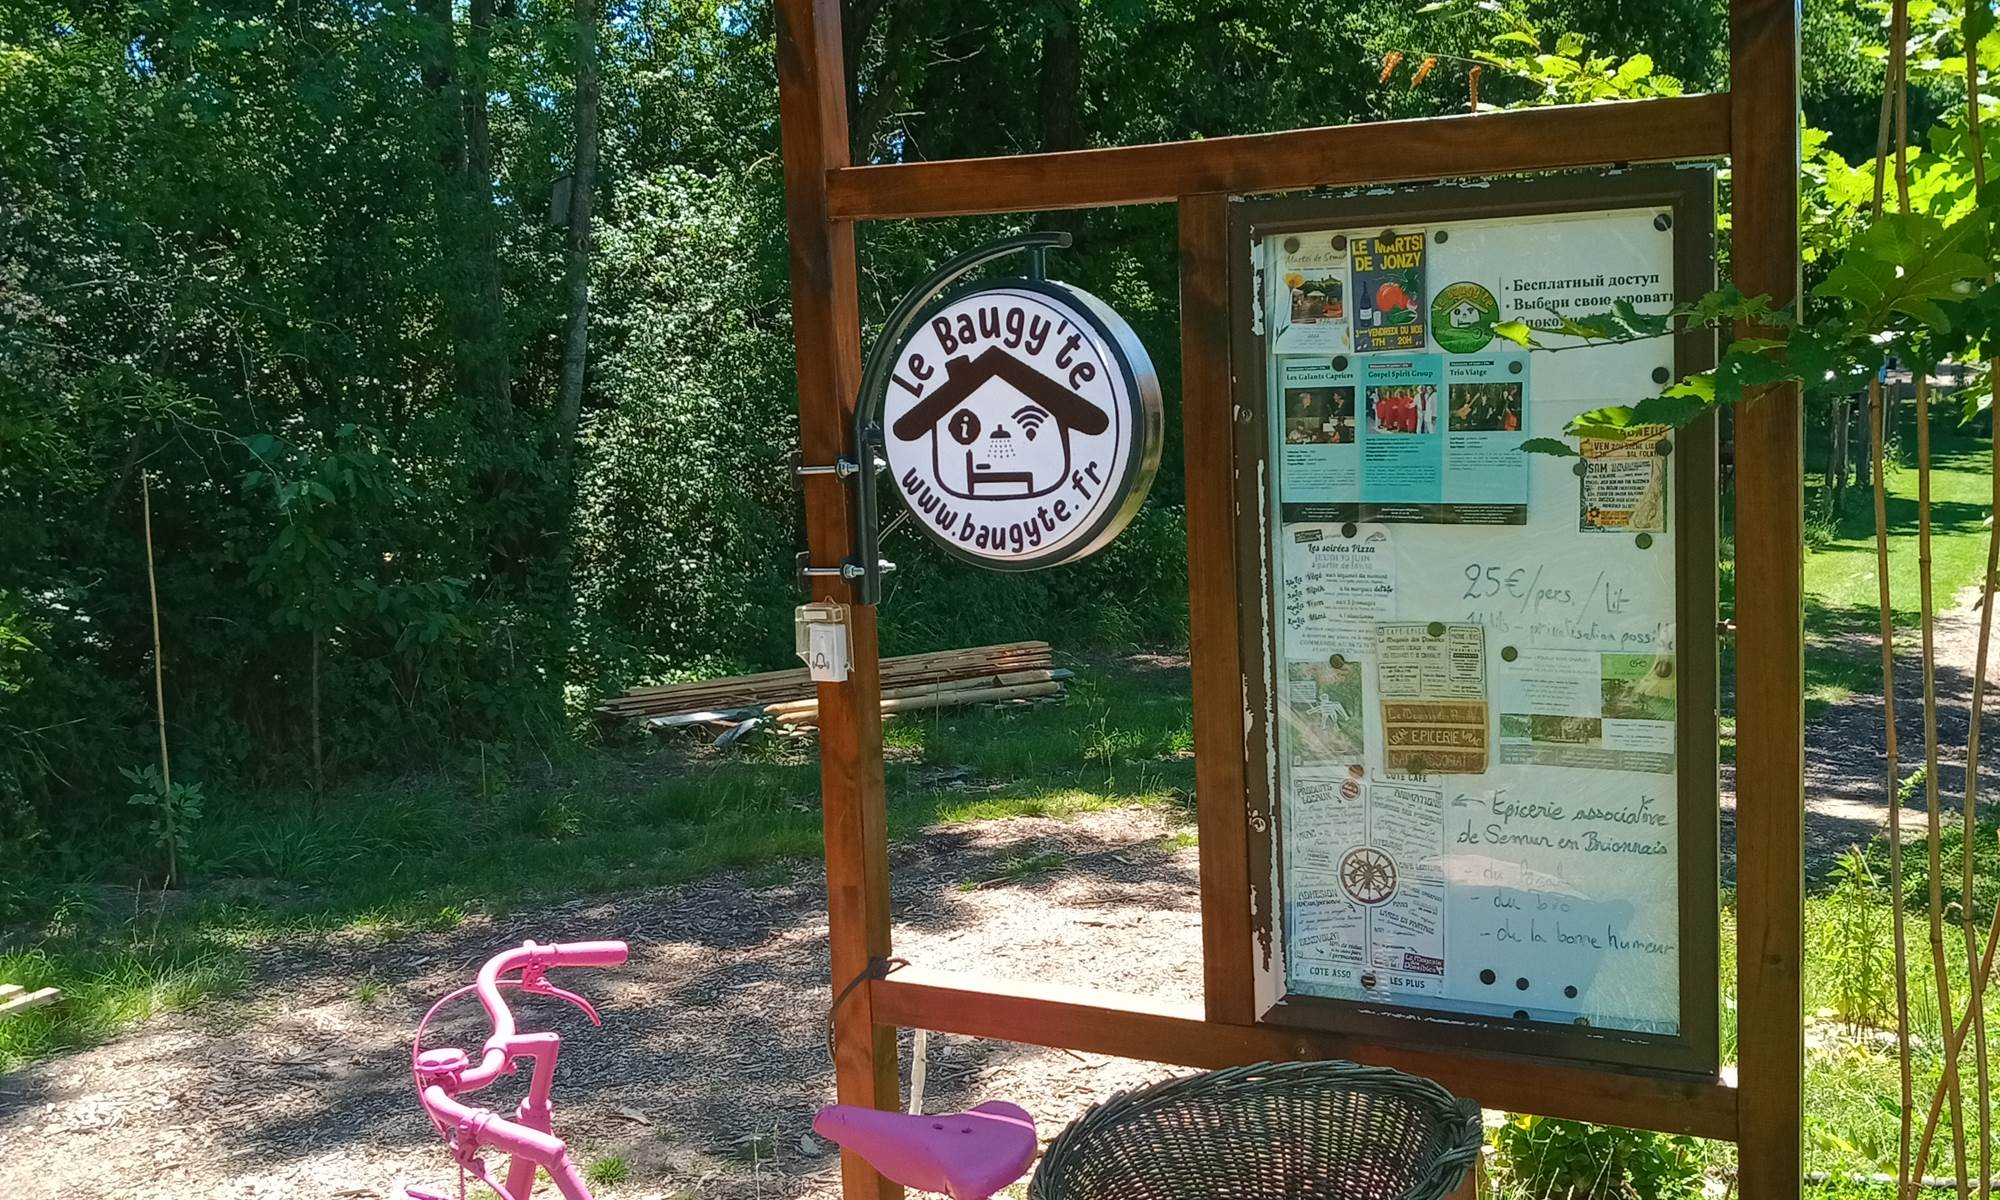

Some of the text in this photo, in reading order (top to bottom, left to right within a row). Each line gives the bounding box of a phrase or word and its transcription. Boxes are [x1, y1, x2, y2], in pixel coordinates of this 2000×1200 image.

[1351, 239, 1369, 256] LE
[1355, 251, 1422, 272] DE JONZY
[1512, 272, 1660, 293] Бесплатный доступ
[1512, 296, 1571, 313] Выбери
[1574, 294, 1612, 308] свою
[1371, 337, 1386, 347] 17H
[1396, 335, 1413, 346] 20H
[891, 306, 1096, 398] Le Baugy'te
[1299, 373, 1325, 381] Galants
[1391, 369, 1411, 379] Spirit
[1411, 369, 1434, 378] Group
[1450, 368, 1465, 376] Trio
[1594, 441, 1610, 451] VEN
[901, 460, 1102, 553] www.baugyte.fr
[1308, 543, 1376, 554] Les soirées Pizza
[1411, 729, 1460, 745] EPICERIE
[1570, 794, 1670, 828] associative
[1456, 818, 1480, 845] de
[1484, 823, 1555, 848] Semur
[1557, 838, 1581, 852] en
[1581, 830, 1670, 857] Brionnais
[1482, 862, 1505, 880] du
[1492, 888, 1522, 911] du
[1495, 917, 1523, 944] de
[1530, 917, 1548, 944] la
[1556, 920, 1604, 950] bonne
[1309, 966, 1352, 979] COTE ASSO
[1390, 976, 1426, 990] LES PLUS
